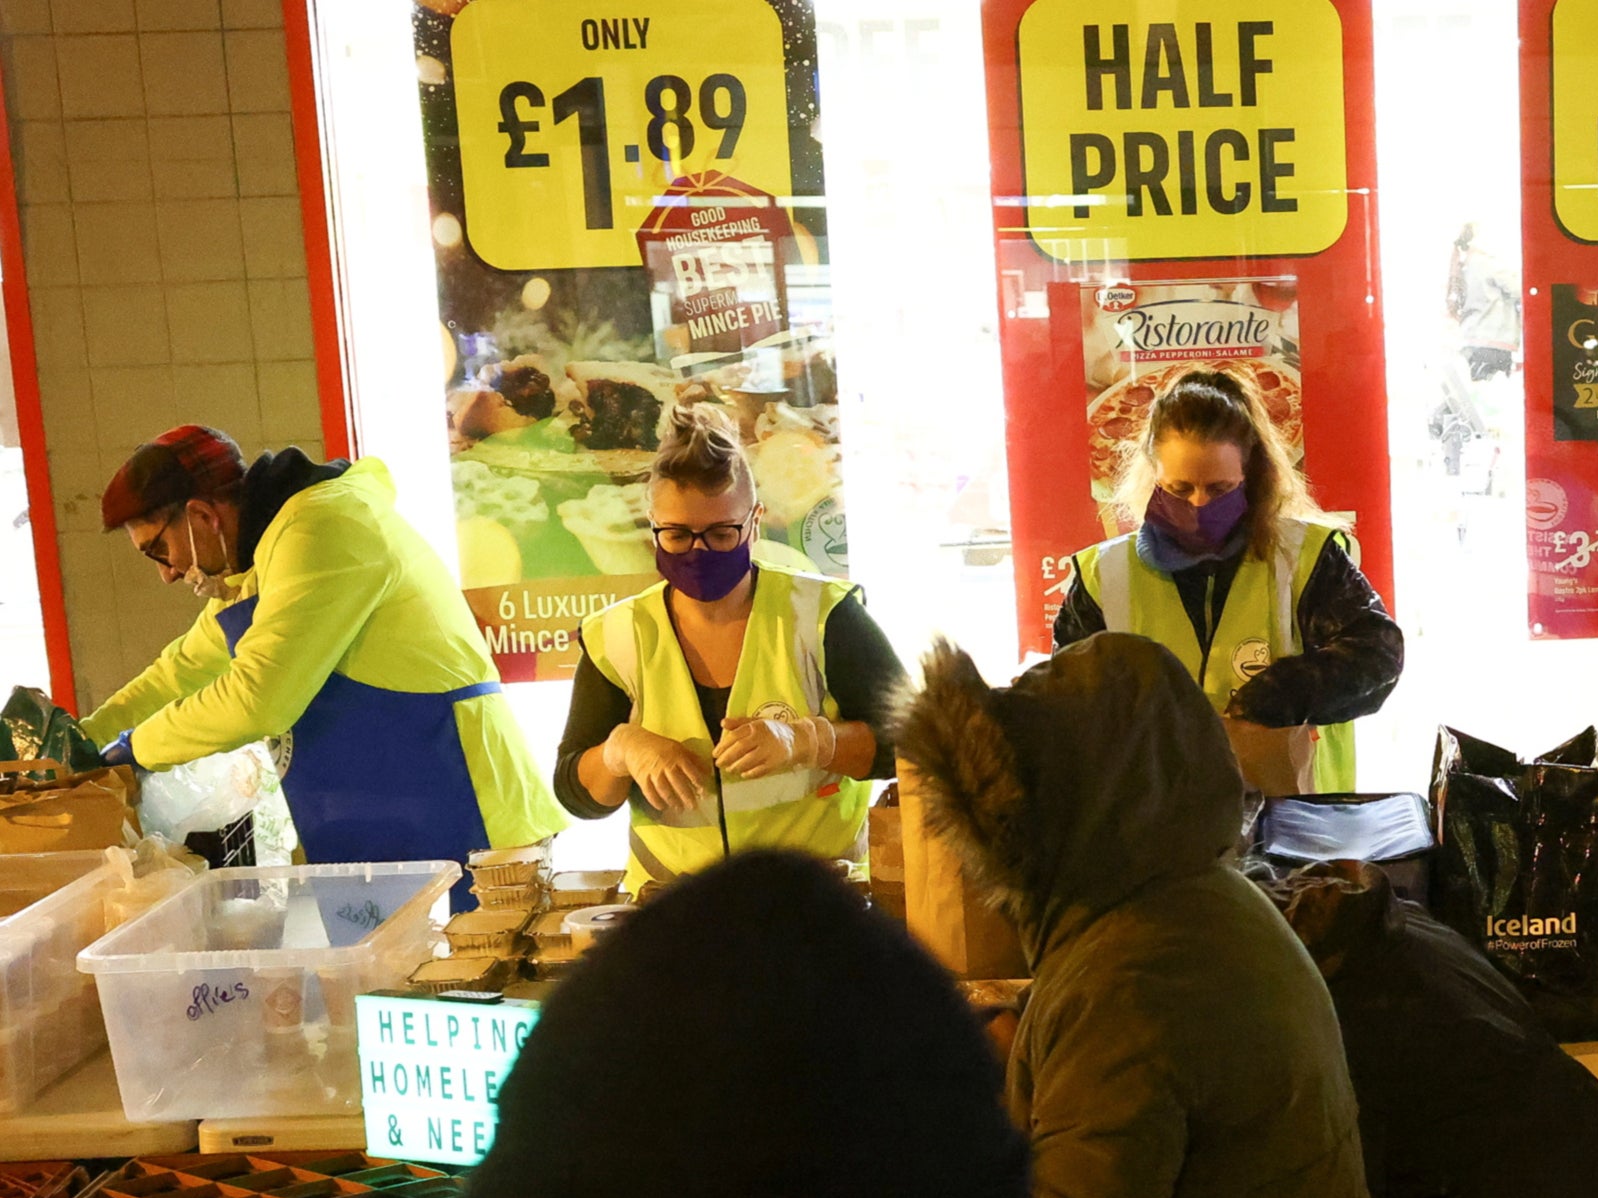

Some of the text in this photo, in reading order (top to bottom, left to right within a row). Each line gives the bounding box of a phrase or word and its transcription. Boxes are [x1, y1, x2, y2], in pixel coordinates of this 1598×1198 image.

[581, 18, 650, 51] ONLY
[1083, 21, 1274, 111] HALF
[497, 73, 747, 231] £1.89
[1069, 128, 1298, 219] PRICE
[690, 206, 727, 227] GOOD
[666, 217, 761, 252] HOUSEKEEPING
[671, 235, 768, 297] BEST
[688, 300, 782, 340] MINCE PIE
[1115, 309, 1270, 351] Ristorante
[1583, 387, 1594, 405] 2
[499, 590, 616, 620] 6 Luxury
[485, 624, 569, 655] Mince
[1487, 912, 1576, 936] Iceland
[379, 1010, 528, 1052] HELPING
[388, 1114, 403, 1146] &
